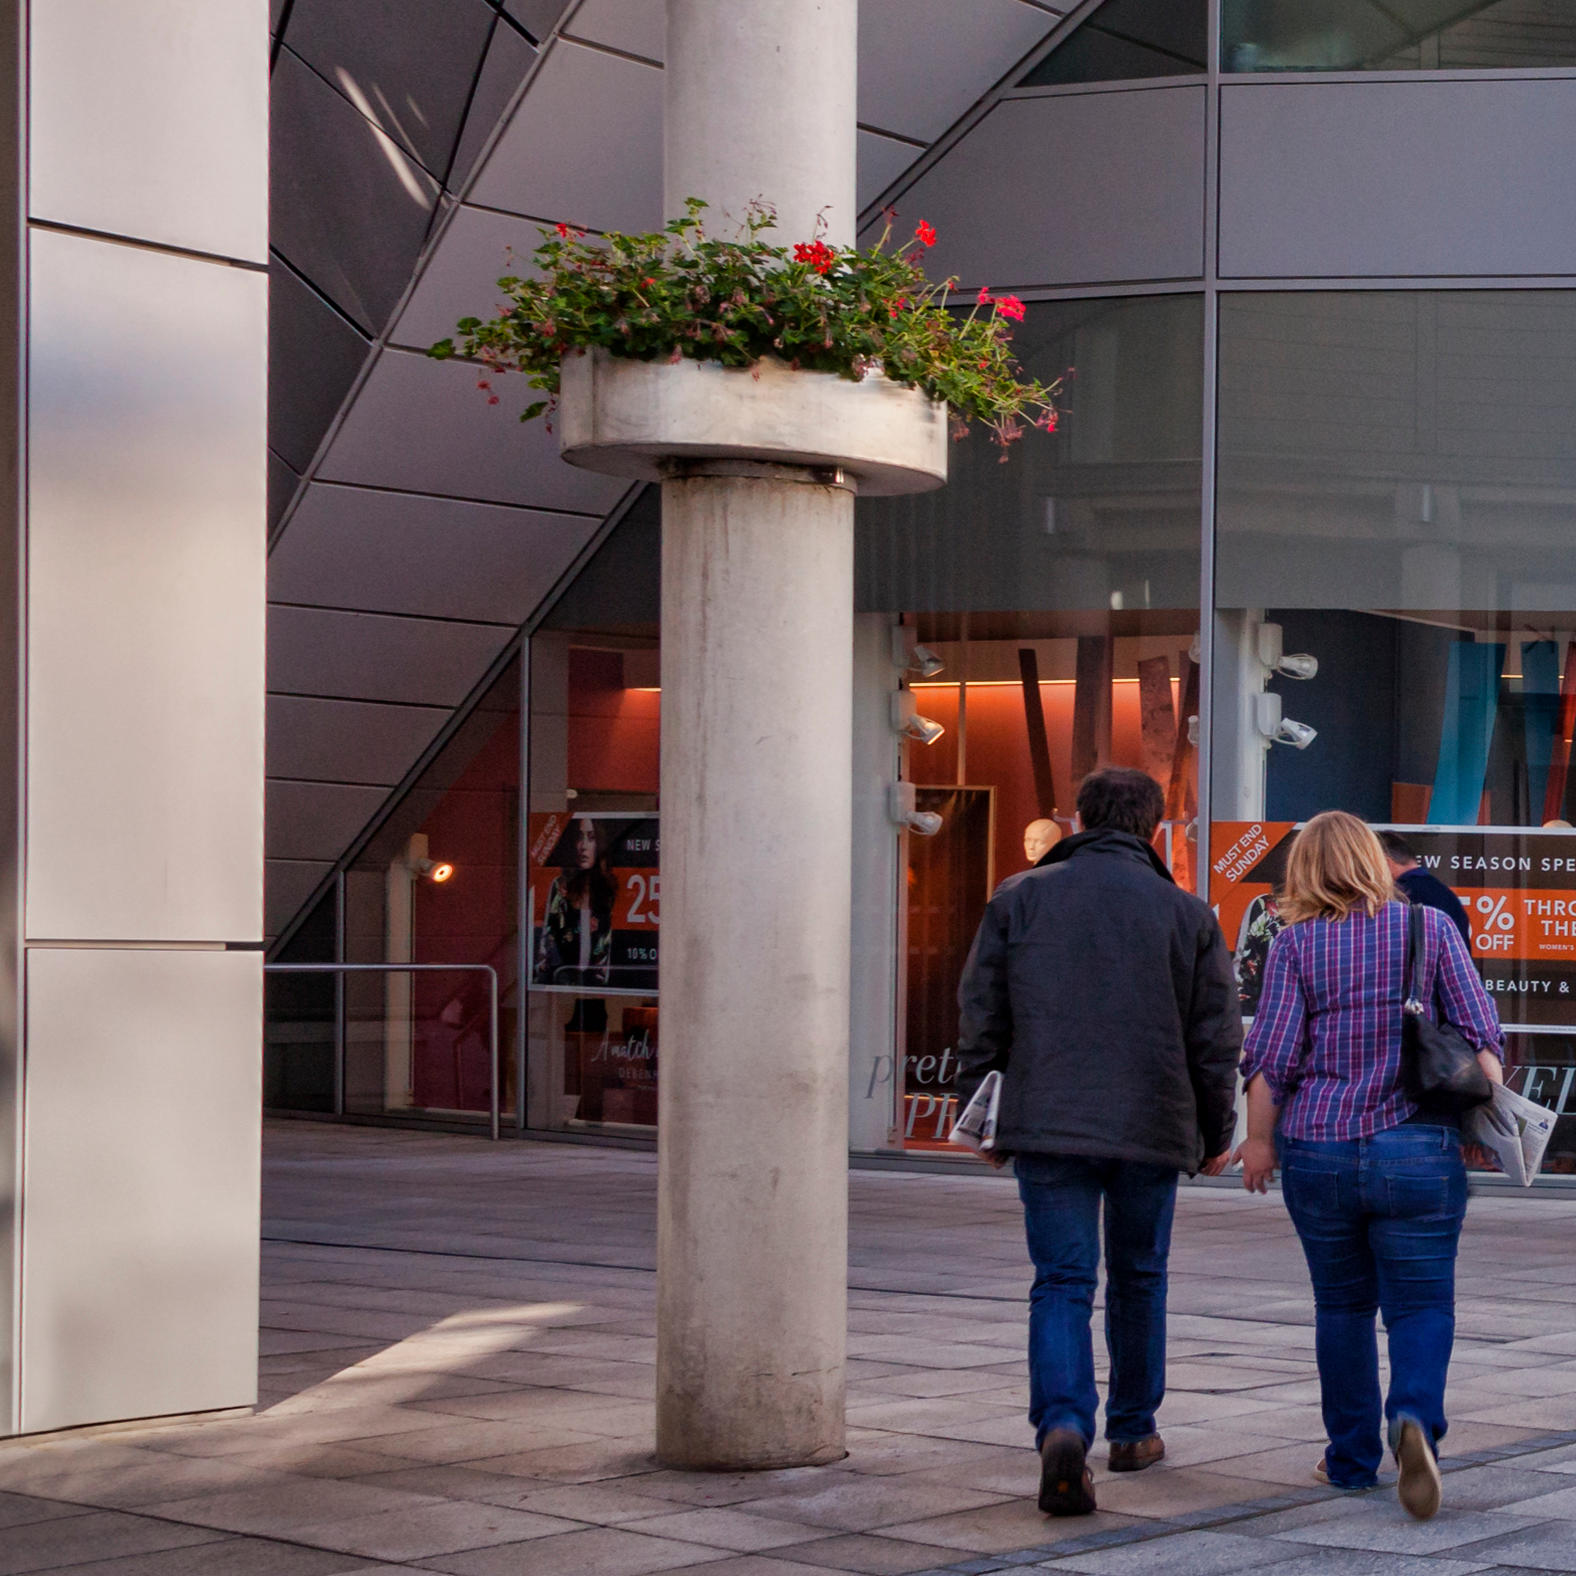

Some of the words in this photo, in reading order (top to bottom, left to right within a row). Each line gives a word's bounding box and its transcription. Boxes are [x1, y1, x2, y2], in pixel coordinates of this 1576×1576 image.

[627, 839, 650, 851] NEW
[1213, 843, 1242, 874] MUST
[1239, 824, 1262, 848] END
[1225, 835, 1270, 883] SUNDAY
[1417, 855, 1442, 869] EW
[1451, 855, 1531, 871] SEASON
[1476, 934, 1515, 951] OFF
[1485, 979, 1551, 993] BEAUTY
[1559, 981, 1570, 993] &
[864, 1048, 961, 1099] pret
